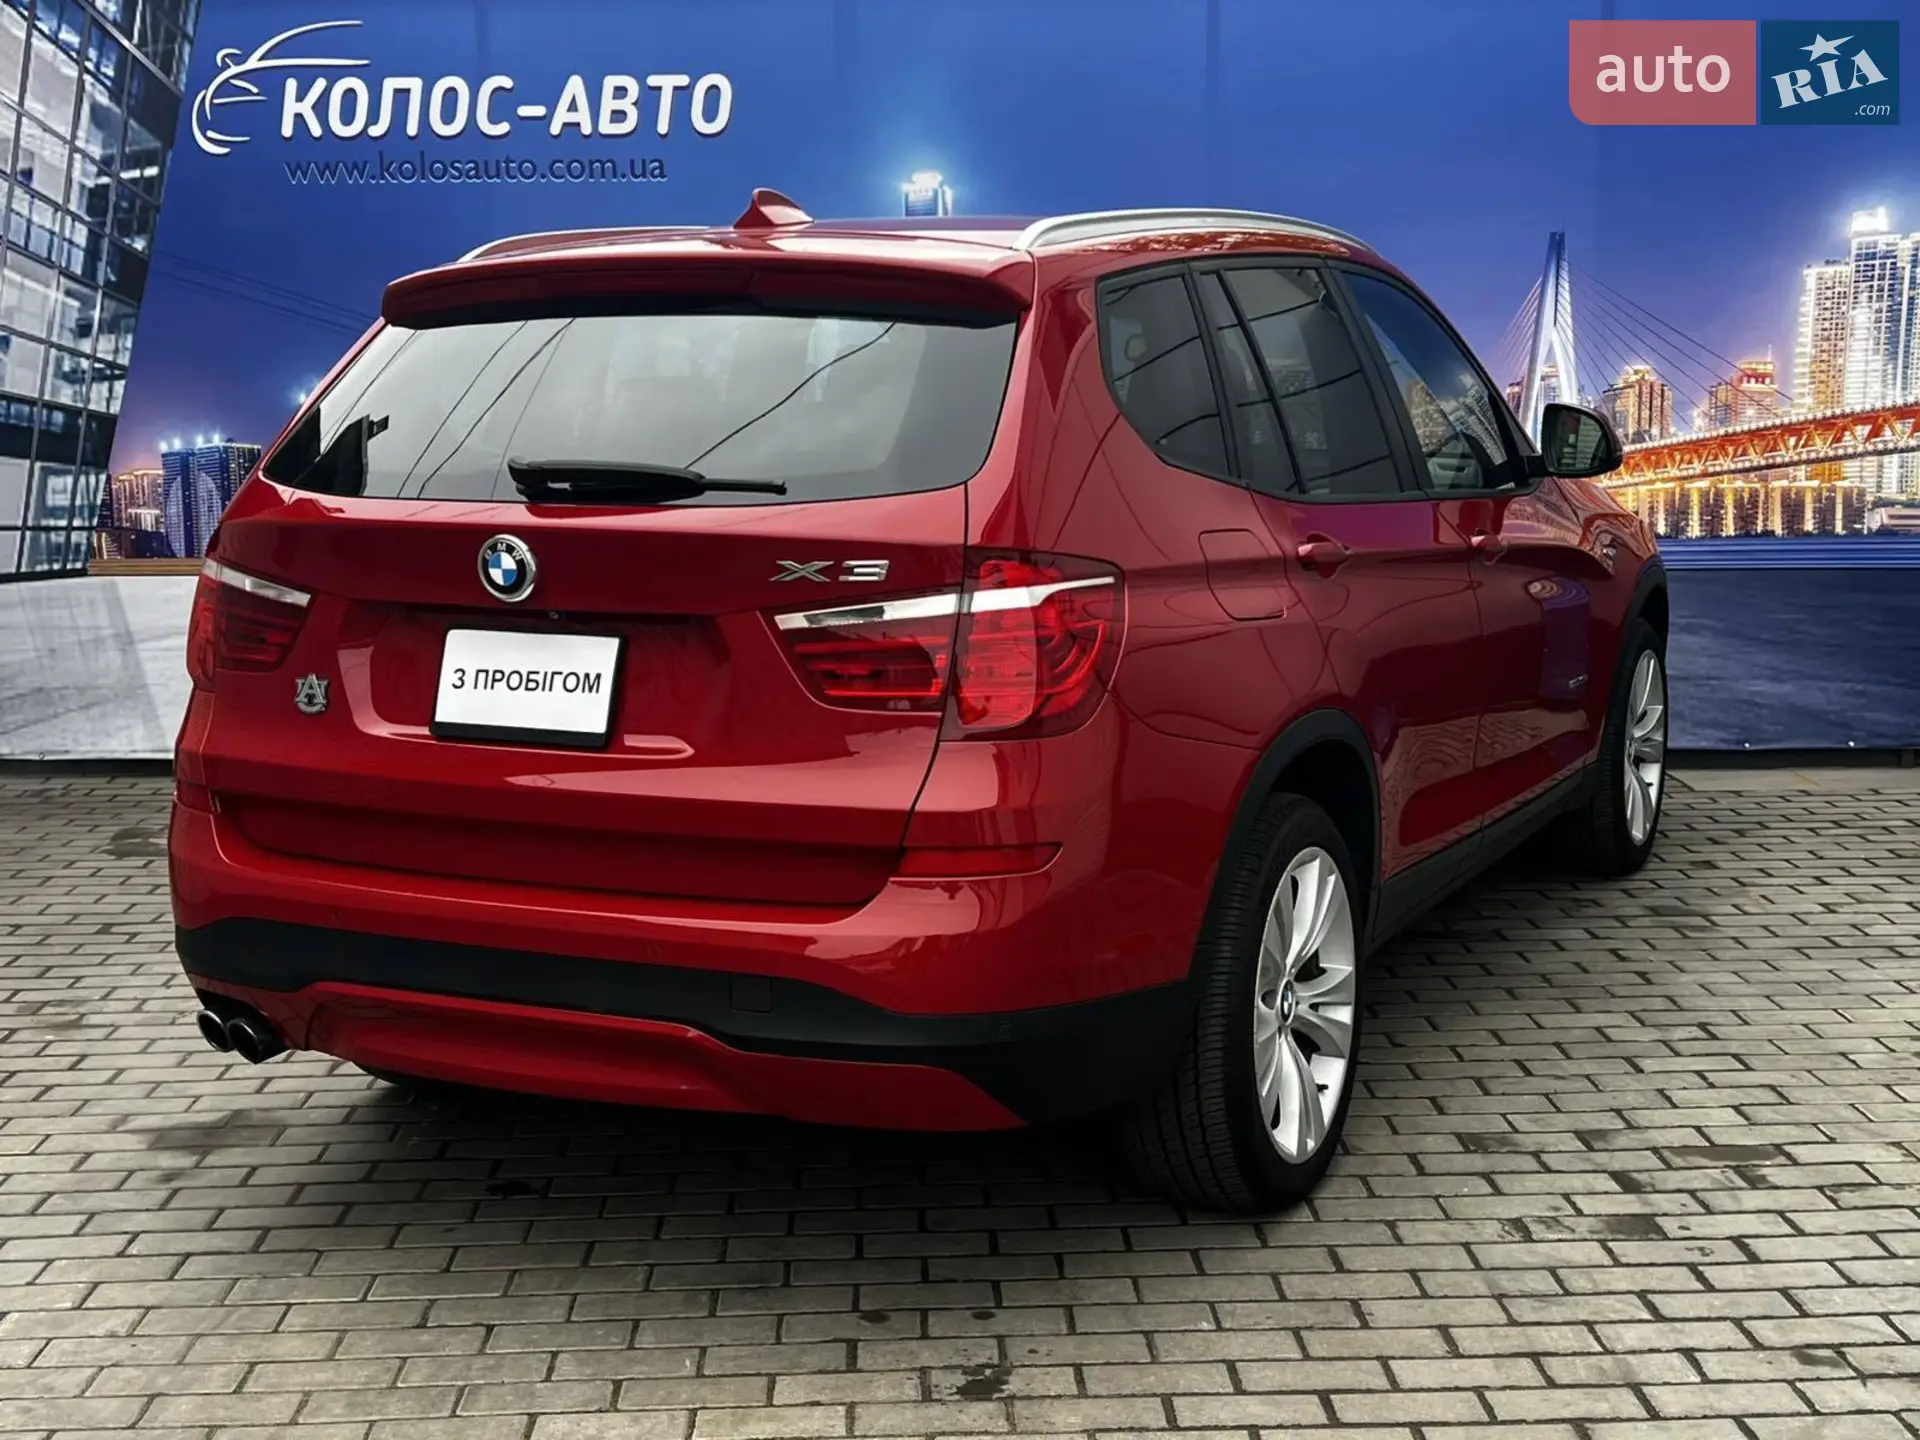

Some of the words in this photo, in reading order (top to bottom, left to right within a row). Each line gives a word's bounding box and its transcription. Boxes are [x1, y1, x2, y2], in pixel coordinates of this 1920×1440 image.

[280, 73, 733, 138] КОЛОС-АВТО
[283, 151, 668, 185] www.kolosauto.com.ua
[768, 559, 890, 583] X3
[473, 669, 602, 694] ПРОБІГОМ
